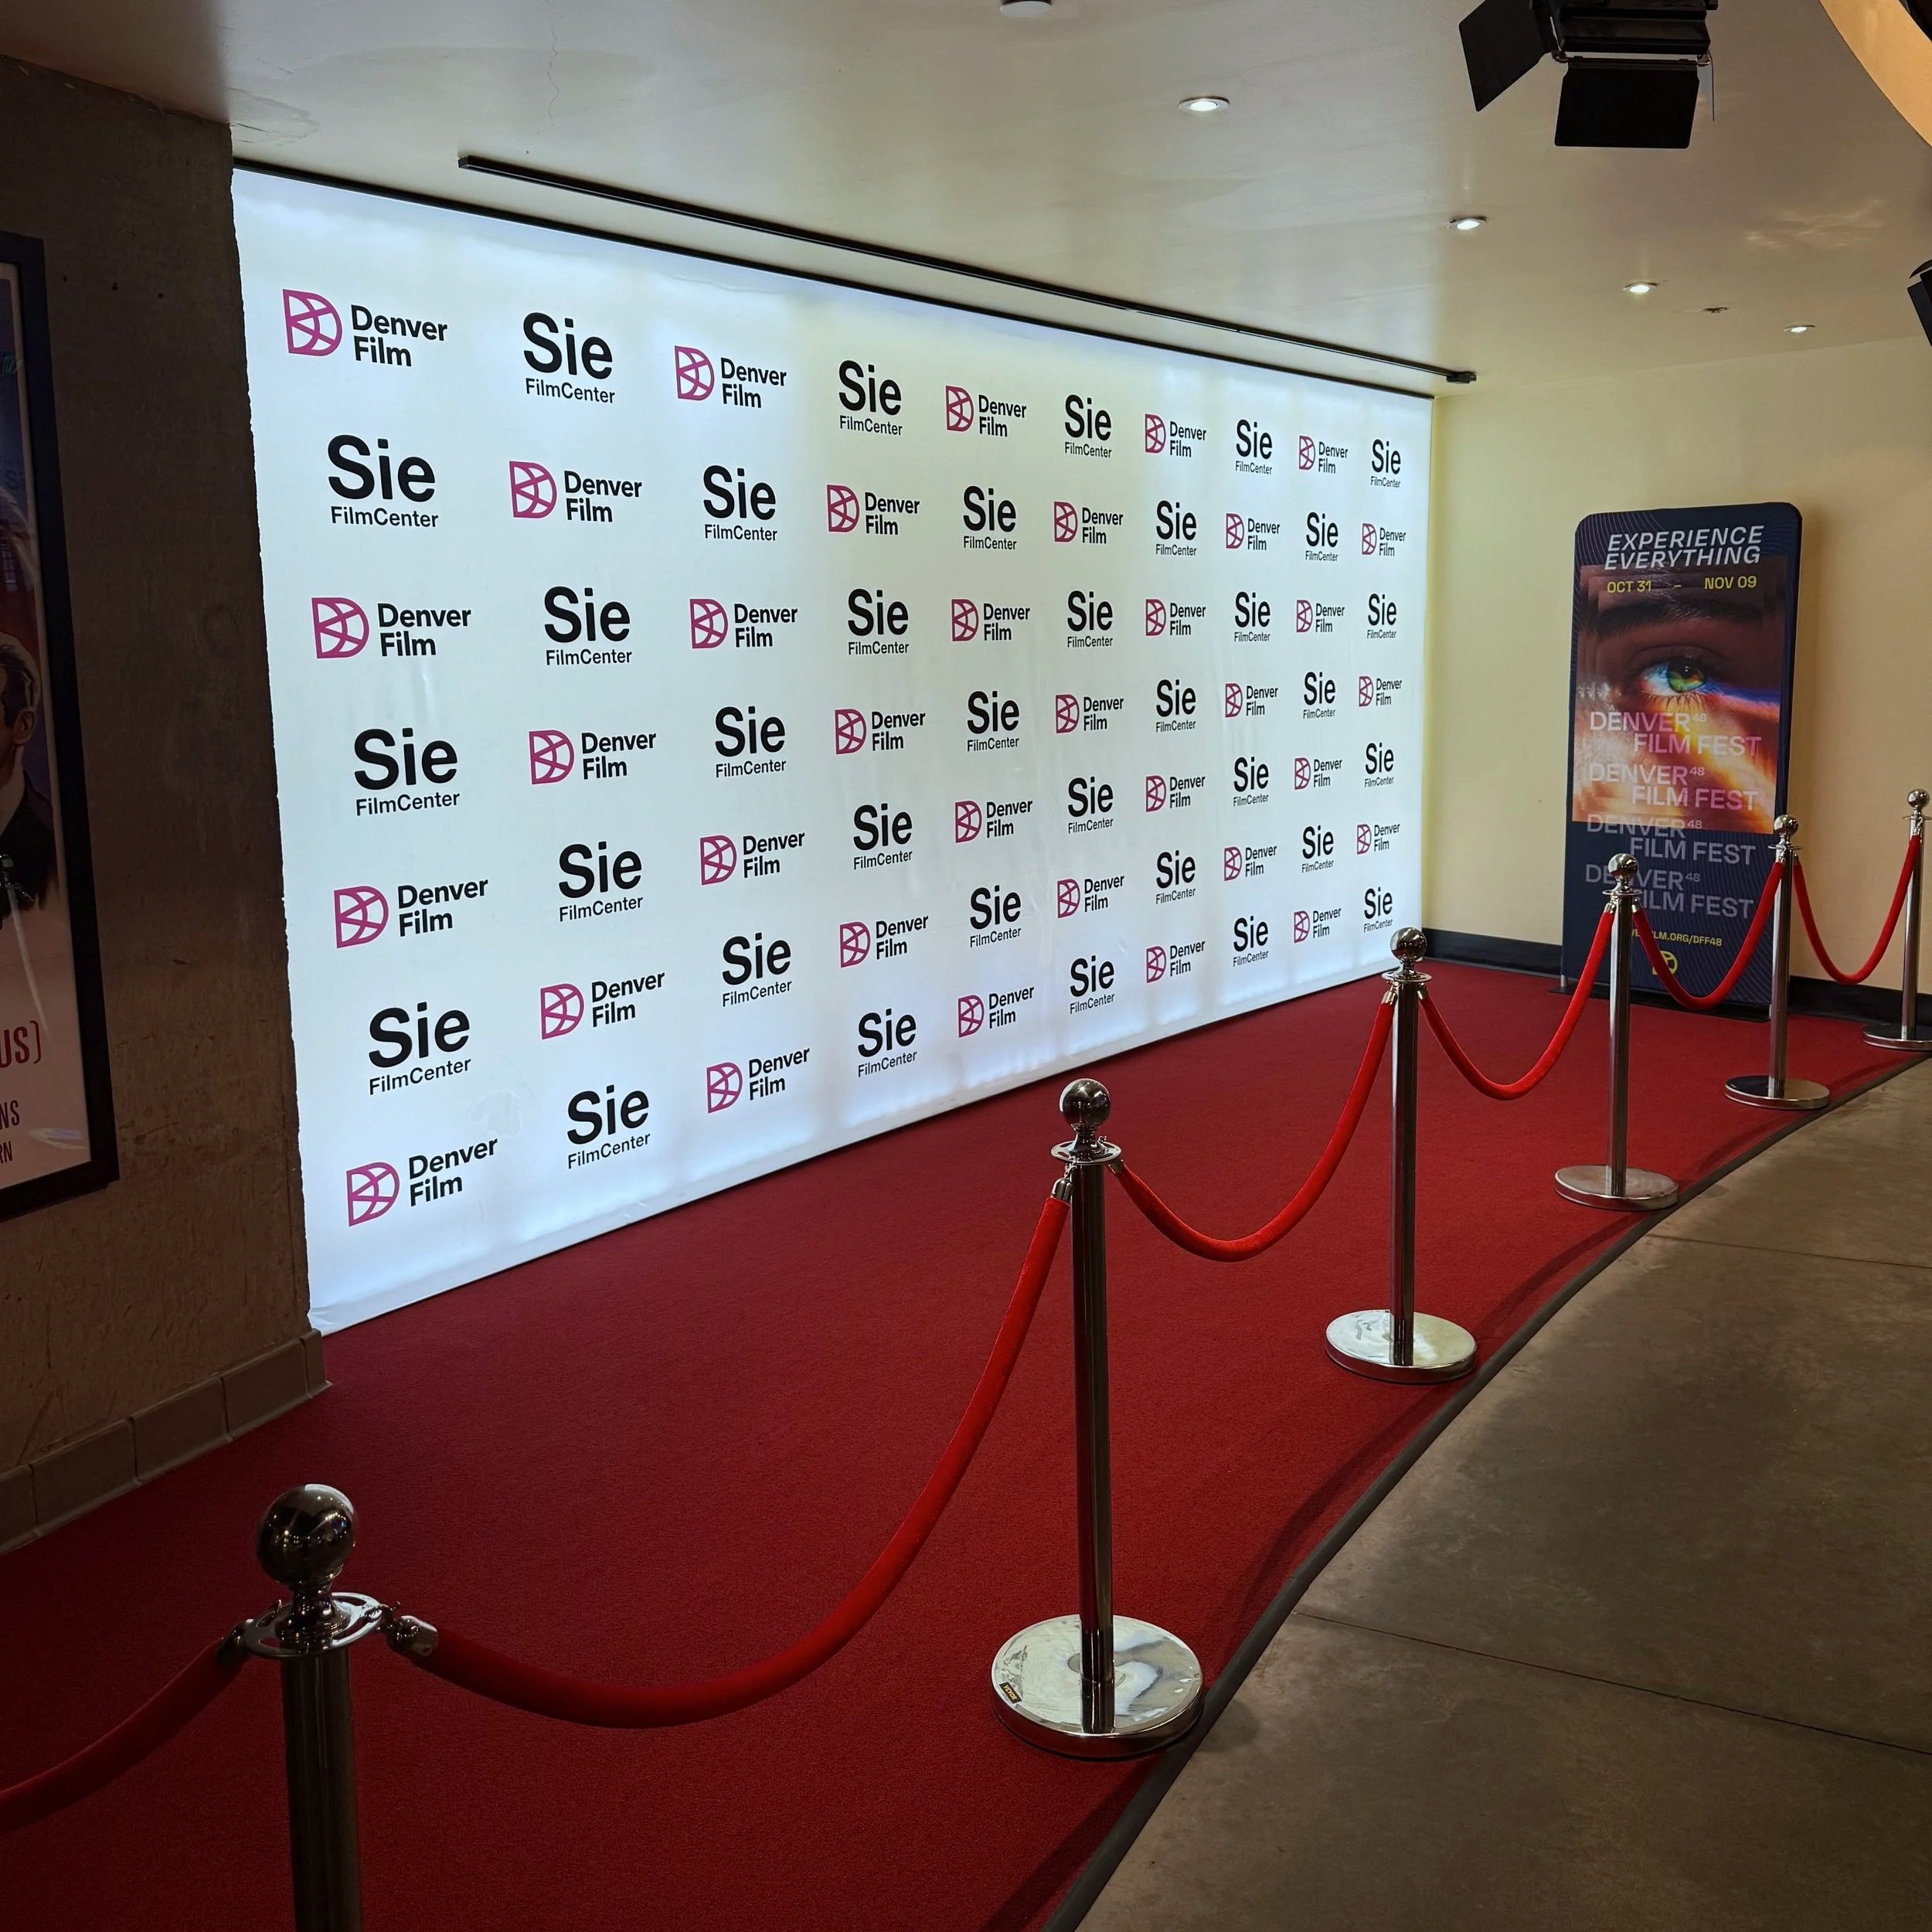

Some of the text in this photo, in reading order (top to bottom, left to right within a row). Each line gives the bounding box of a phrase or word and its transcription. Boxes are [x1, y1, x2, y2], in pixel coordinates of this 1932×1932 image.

[351, 304, 447, 341] Denver
[354, 335, 411, 366] Film
[523, 312, 612, 379] Sie
[721, 357, 787, 386] Denver
[526, 378, 615, 403] FilmCenter
[723, 383, 761, 408] Film
[839, 360, 901, 415] Sie
[978, 395, 1026, 418] Denver
[1065, 395, 1111, 440] Sie
[840, 415, 903, 435] FilmCenter
[979, 417, 1008, 437] Film
[1170, 421, 1206, 440] Denver
[1065, 442, 1111, 457] FilmCenter
[1170, 440, 1191, 457] Film
[1236, 420, 1272, 459] Sie
[1319, 441, 1348, 458] Denver
[1372, 439, 1400, 474] Sie
[328, 435, 435, 502] Sie
[564, 471, 642, 497] Denver
[703, 465, 776, 520] Sie
[566, 498, 612, 522] Film
[865, 492, 920, 514] Denver
[964, 486, 1016, 532] Sie
[331, 506, 438, 527] FilmCenter
[866, 515, 898, 535] Film
[1082, 507, 1123, 526] Denver
[1156, 500, 1196, 540] Sie
[1248, 518, 1280, 534] Denver
[705, 524, 777, 541] FilmCenter
[1083, 526, 1107, 544] Film
[1306, 512, 1338, 547] Sie
[1380, 528, 1406, 541] Denver
[1607, 525, 1764, 552] EXPERIENCE
[964, 536, 1017, 549] FilmCenter
[1156, 544, 1196, 556] FilmCenter
[1248, 535, 1267, 550] Film
[1604, 545, 1760, 570] EVERYTHING
[1607, 575, 1757, 593] OCT 31 NOV 09
[378, 604, 471, 628] Denver
[545, 587, 630, 643] Sie
[734, 604, 798, 624] Denver
[848, 589, 908, 636] Sie
[984, 604, 1030, 621] Denver
[1067, 590, 1113, 631] Sie
[1170, 603, 1206, 617] Denver
[1235, 591, 1270, 628] Sie
[1316, 603, 1345, 617] Denver
[1368, 594, 1396, 626] Sie
[984, 622, 1012, 641] Film
[1170, 620, 1191, 635] Film
[1316, 618, 1332, 632] Film
[380, 631, 436, 656] Film
[736, 626, 773, 648] Film
[849, 641, 909, 655] FilmCenter
[1067, 636, 1113, 648] FilmCenter
[546, 649, 632, 665] FilmCenter
[1247, 685, 1278, 699] Denver
[1304, 672, 1335, 706] Sie
[1376, 679, 1402, 690] Denver
[1083, 697, 1124, 713] Denver
[1156, 679, 1196, 717] Sie
[1247, 701, 1264, 716] Film
[872, 712, 926, 730] Denver
[968, 691, 1019, 734] Sie
[1083, 713, 1107, 731] Film
[1590, 711, 1690, 732] DENVER
[715, 706, 785, 757] Sie
[1156, 720, 1196, 732] FilmCenter
[582, 733, 656, 754] Denver
[872, 731, 903, 751] Film
[968, 737, 1019, 752] FilmCenter
[1634, 733, 1762, 757] FILM FEST
[355, 728, 457, 790] Sie
[583, 756, 627, 780] Film
[716, 760, 786, 777] FilmCenter
[1314, 759, 1342, 772] Denver
[1366, 743, 1393, 774] Sie
[1170, 777, 1205, 791] Denver
[1234, 757, 1269, 792] Sie
[1588, 763, 1689, 785] DENVER
[356, 792, 460, 816] FilmCenter
[1068, 777, 1113, 817] Sie
[1170, 792, 1190, 808] Film
[1631, 785, 1759, 811] FILM FEST
[987, 801, 1032, 818] Denver
[853, 803, 912, 850] Sie
[987, 819, 1014, 838] Film
[1068, 818, 1114, 834] FilmCenter
[1375, 824, 1400, 836] Denver
[1587, 814, 1685, 838] DENVER
[743, 832, 804, 855] Denver
[1246, 846, 1277, 861] Denver
[1302, 825, 1334, 859] Sie
[1630, 837, 1757, 866] FILM FEST
[559, 842, 641, 898] Sie
[744, 855, 780, 878] Film
[854, 851, 913, 869] FilmCenter
[1156, 850, 1196, 889] Sie
[1246, 862, 1264, 877] Film
[1084, 876, 1124, 894] Denver
[1586, 864, 1683, 890] DEVER
[398, 879, 488, 909] Denver
[1085, 894, 1108, 912] Film
[1156, 889, 1196, 904] FilmCenter
[1364, 887, 1393, 919] Sie
[1641, 890, 1753, 919] ILM FEST
[560, 897, 643, 921] FilmCenter
[970, 885, 1021, 930] Sie
[1313, 909, 1341, 923] Denver
[400, 909, 452, 937] Film
[876, 916, 928, 939] Denver
[1233, 916, 1268, 951] Sie
[1313, 923, 1329, 938] Film
[876, 938, 907, 960] Film
[971, 928, 1021, 947] FilmCenter
[723, 932, 791, 985] Sie
[1170, 941, 1205, 960] Denver
[1070, 955, 1114, 997] Sie
[1170, 959, 1191, 977] Film
[592, 973, 665, 1002] Denver
[723, 981, 791, 1007] FilmCenter
[989, 987, 1034, 1009] Denver
[593, 1002, 635, 1027] Film
[1070, 994, 1114, 1014] FilmCenter
[989, 1009, 1015, 1029] Film
[369, 1002, 470, 1068] Sie
[858, 1009, 916, 1057] Sie
[749, 1048, 810, 1078] Denver
[859, 1052, 917, 1077] FilmCenter
[370, 1059, 471, 1095] FilmCenter
[750, 1077, 785, 1100] Film
[567, 1085, 649, 1145] Sie
[409, 1138, 498, 1179] Denver
[568, 1134, 650, 1168] FilmCenter
[410, 1175, 462, 1206] Film
